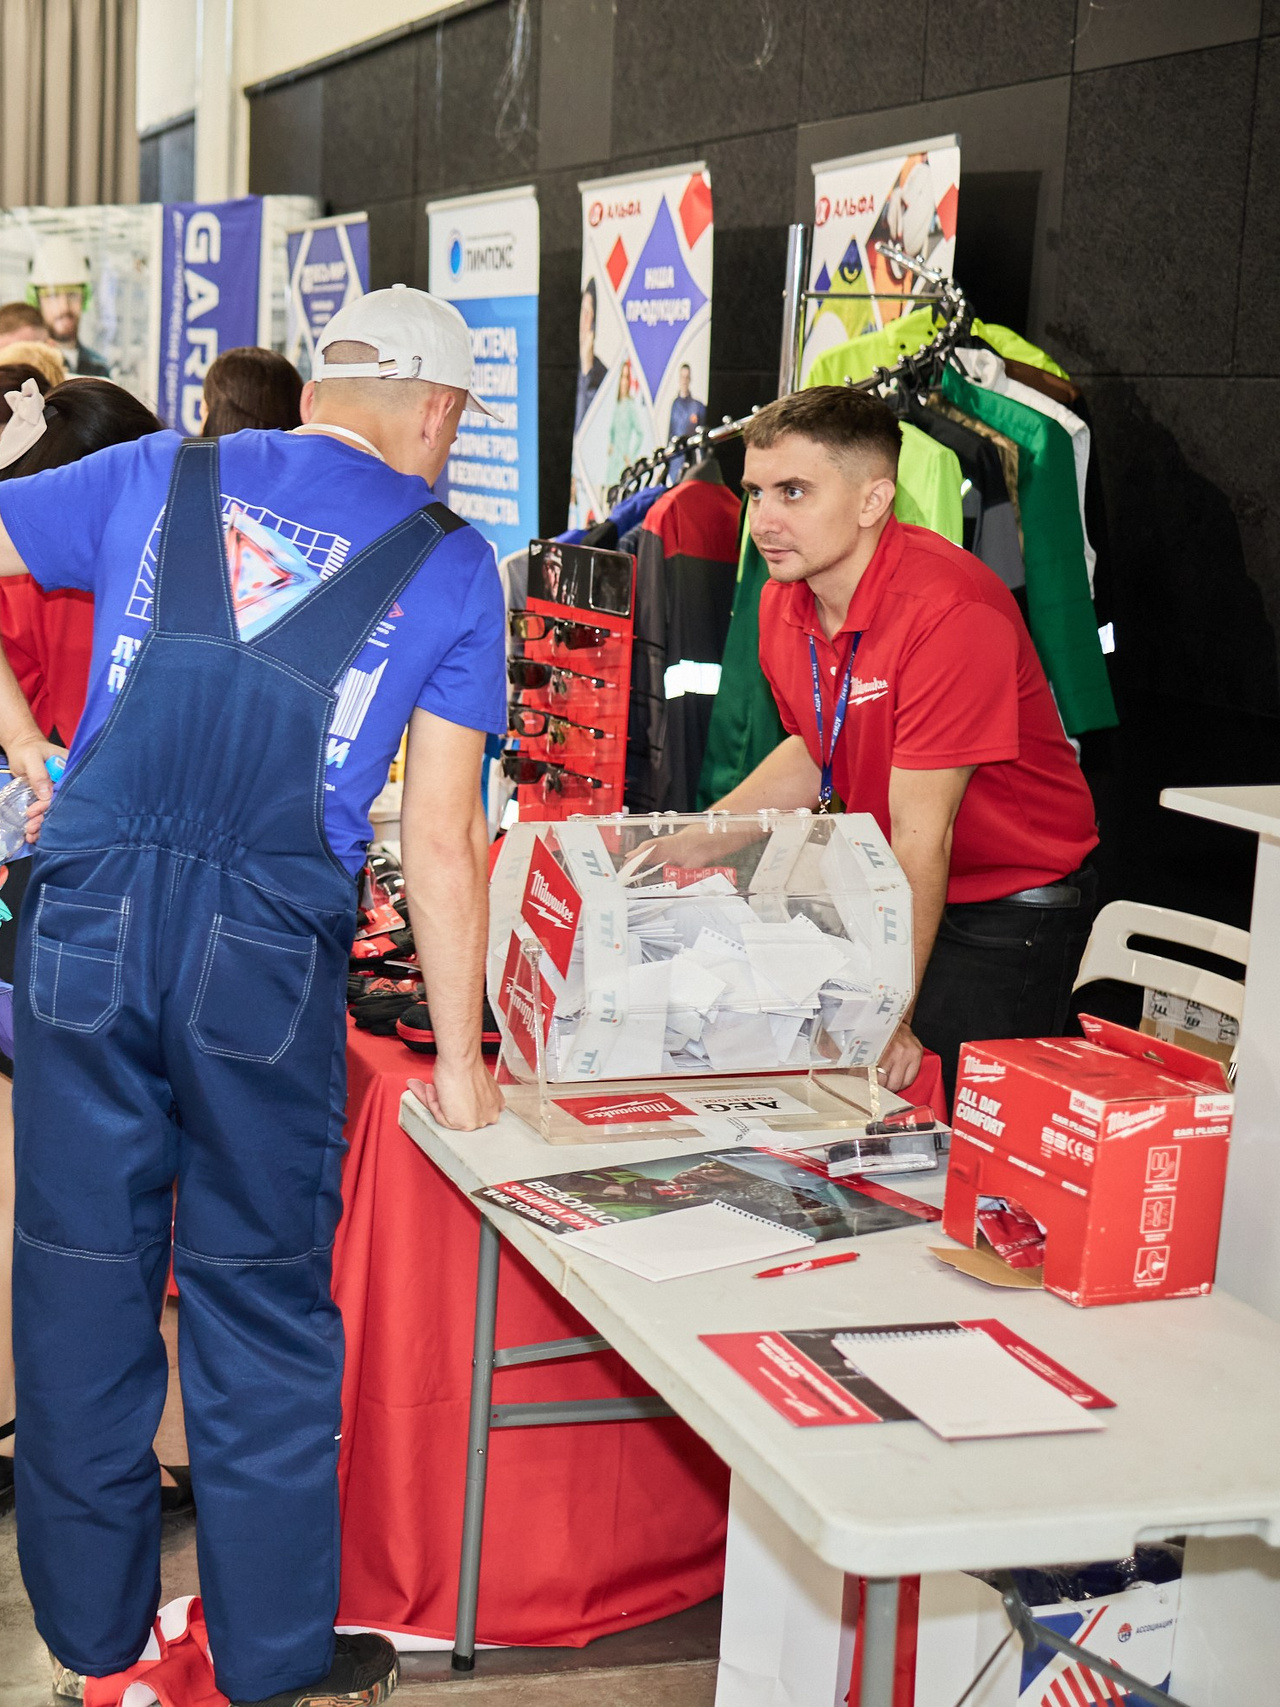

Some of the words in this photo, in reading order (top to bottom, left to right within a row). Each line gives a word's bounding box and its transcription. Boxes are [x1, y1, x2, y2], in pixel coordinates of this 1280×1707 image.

[531, 869, 574, 923] Milwaukee
[587, 1101, 678, 1119] Milwaukee
[704, 1100, 782, 1113] AEG
[958, 1087, 977, 1107] ALL
[979, 1095, 1002, 1117] DAY
[956, 1103, 1006, 1137] COMFORT
[493, 1191, 513, 1204] НЕ
[504, 1185, 563, 1215] ЗАЩИТА
